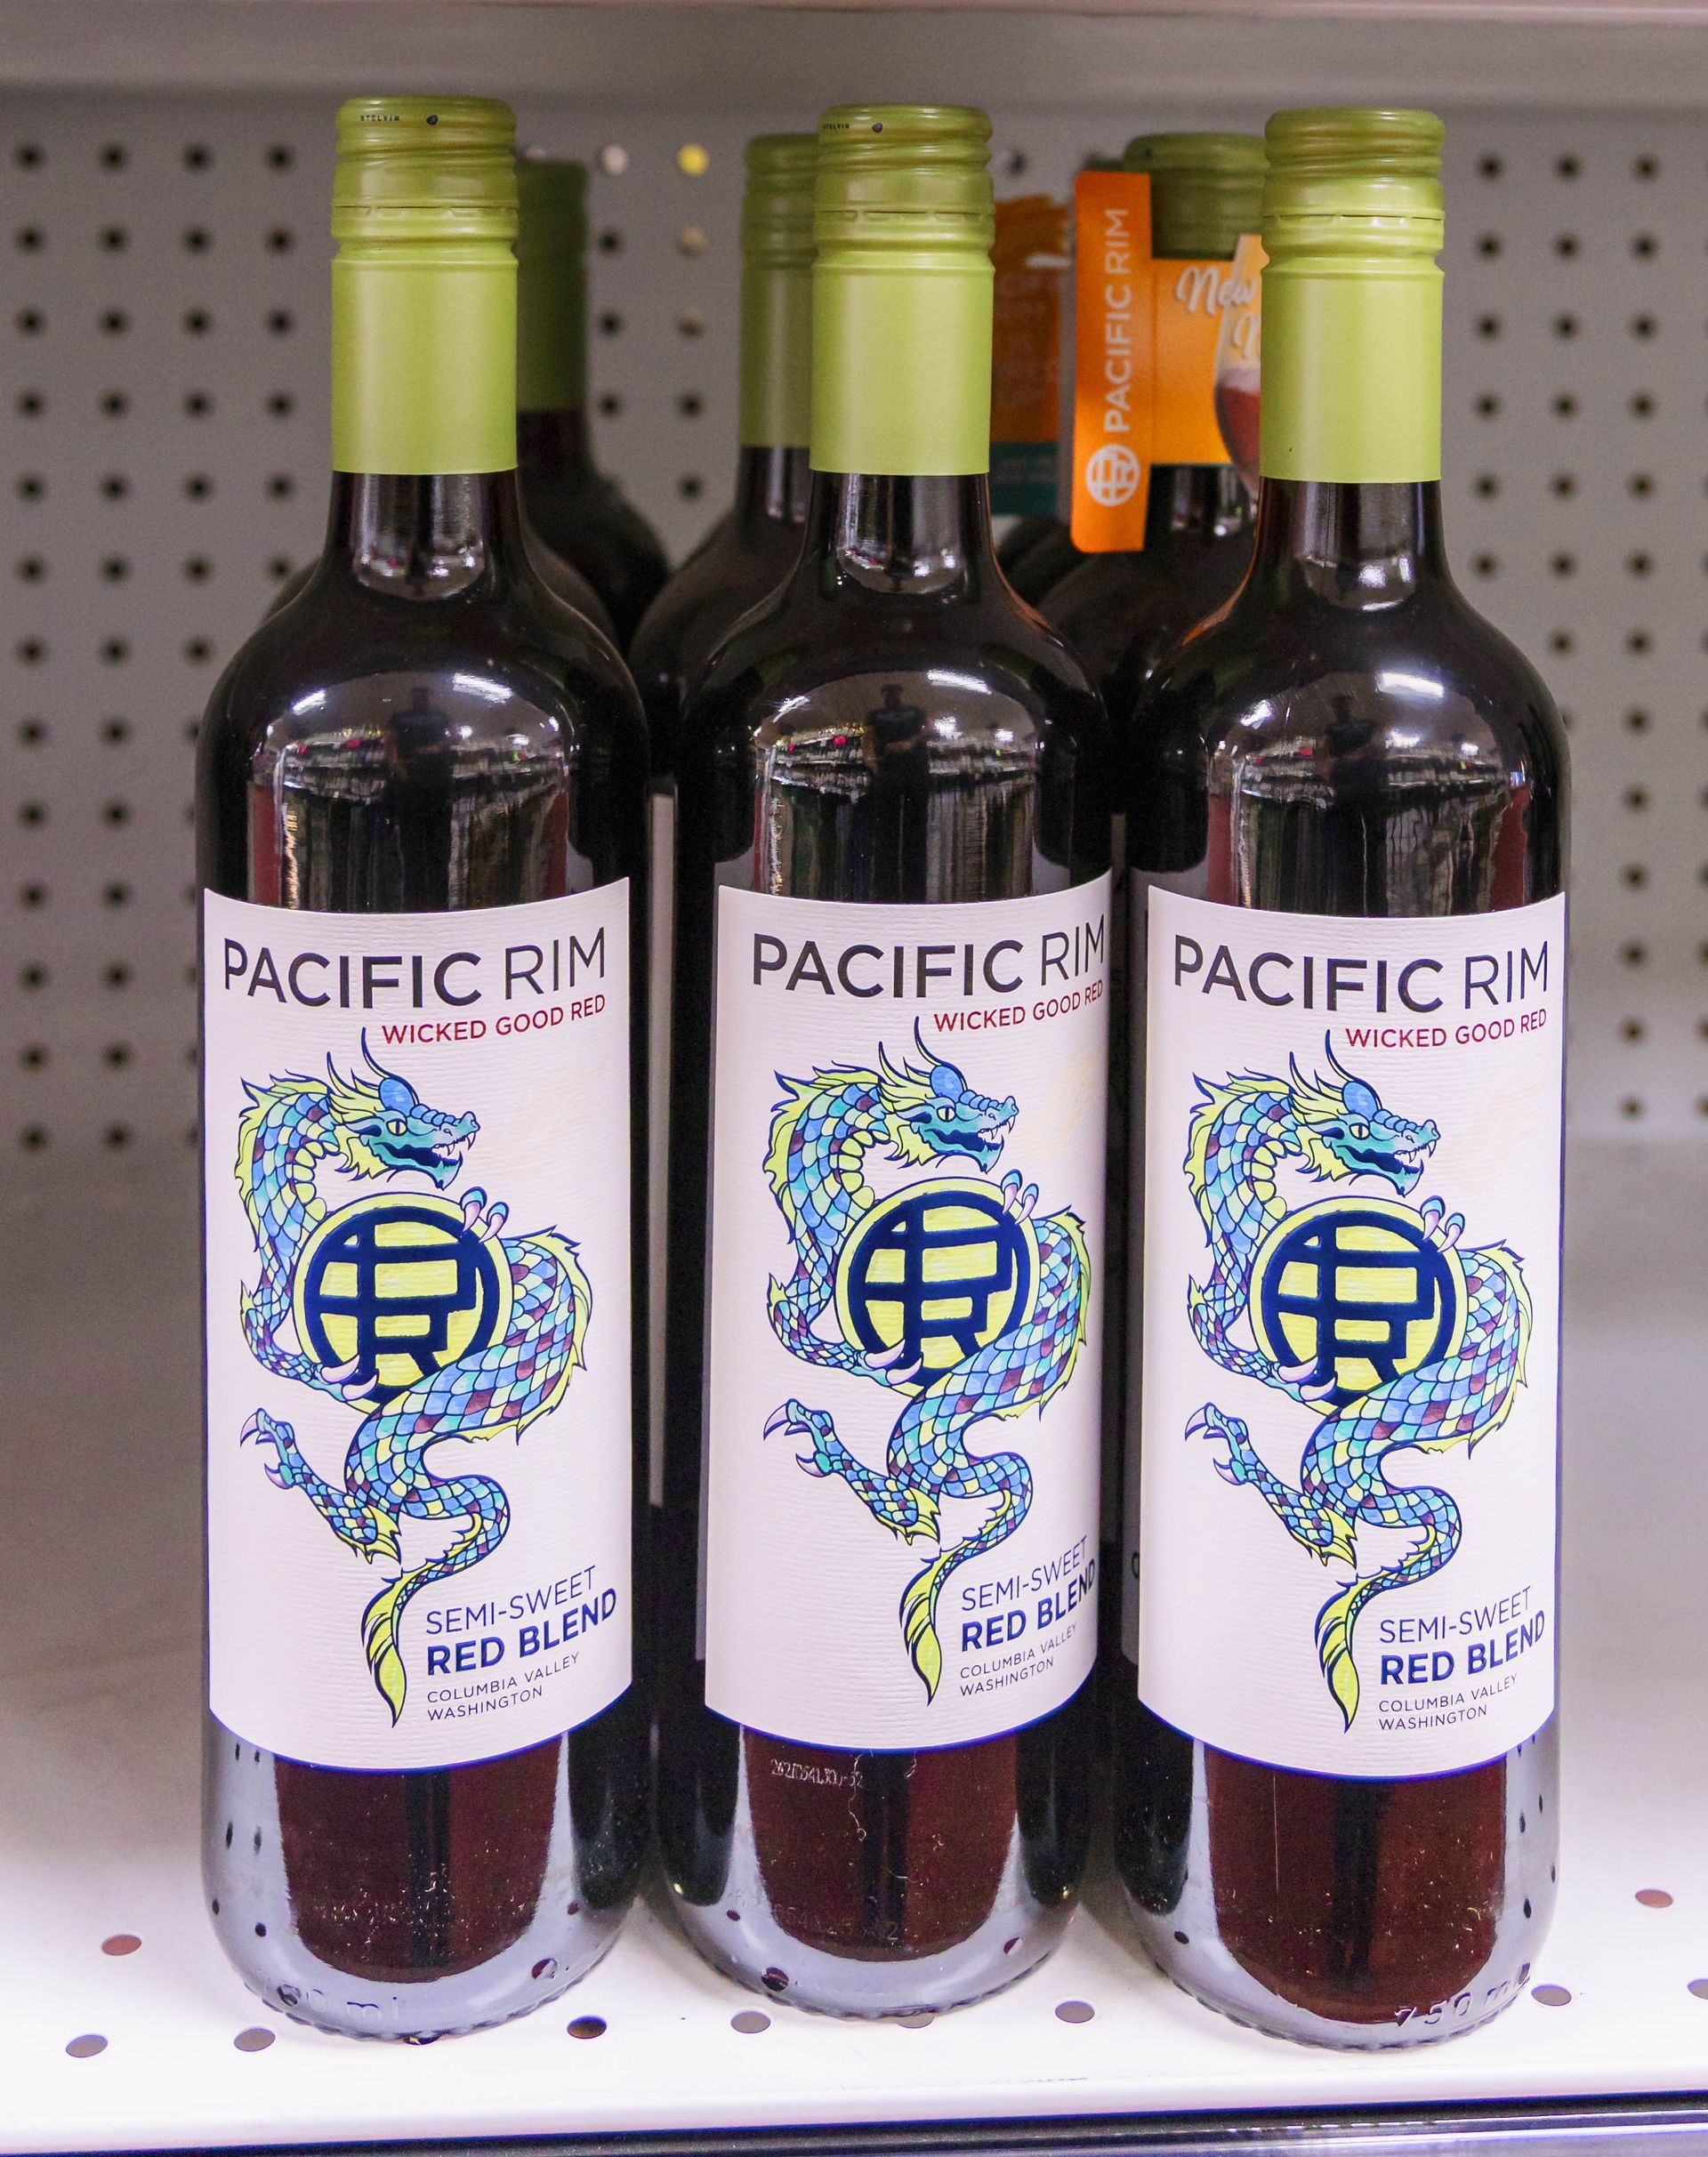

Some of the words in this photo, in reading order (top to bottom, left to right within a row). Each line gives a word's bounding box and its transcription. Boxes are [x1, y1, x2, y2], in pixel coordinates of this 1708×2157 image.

[1105, 208, 1130, 275] RIM
[1176, 266, 1256, 317] New
[1104, 282, 1132, 433] PACIFIC
[224, 938, 481, 1009] PACIFIC
[504, 927, 606, 1000] RIM
[753, 933, 1025, 998] PACIFIC
[1041, 914, 1105, 986] RIM
[1174, 934, 1444, 1013] PACIFIC
[1464, 940, 1549, 1010] RIM
[382, 1019, 487, 1044] WICKED
[495, 1007, 564, 1035] GOOD
[570, 994, 606, 1019] RED
[933, 1006, 1026, 1033] WICKED
[1032, 991, 1081, 1022] GOOD
[1084, 978, 1104, 1007] RED
[1345, 1027, 1447, 1048] WICKED
[1455, 1018, 1515, 1045] GOOD
[1520, 1008, 1547, 1034] RED
[426, 1565, 596, 1635] SEMI-SWEET
[962, 1535, 1088, 1612] SEMI-SWEET
[427, 1637, 505, 1676] RED
[519, 1588, 616, 1659] BLEND
[962, 1610, 1027, 1652] RED
[1037, 1557, 1096, 1630] BLEND
[1379, 1585, 1531, 1644] SEMI-SWEET
[960, 1648, 1035, 1678] COLUMBIA
[1040, 1622, 1077, 1654] VALLEY
[960, 1656, 1054, 1697] WASHINGTON
[1381, 1651, 1454, 1686] RED
[1468, 1610, 1545, 1675] BLEND
[427, 1677, 518, 1703] COLUMBIA
[524, 1652, 579, 1683] VALLEY
[427, 1685, 543, 1721] WASHINGTON
[1378, 1693, 1465, 1712] COLUMBIA
[1470, 1672, 1519, 1701] VALLEY
[1378, 1704, 1487, 1730] WASHINGTON
[1394, 1992, 1471, 2027] 750
